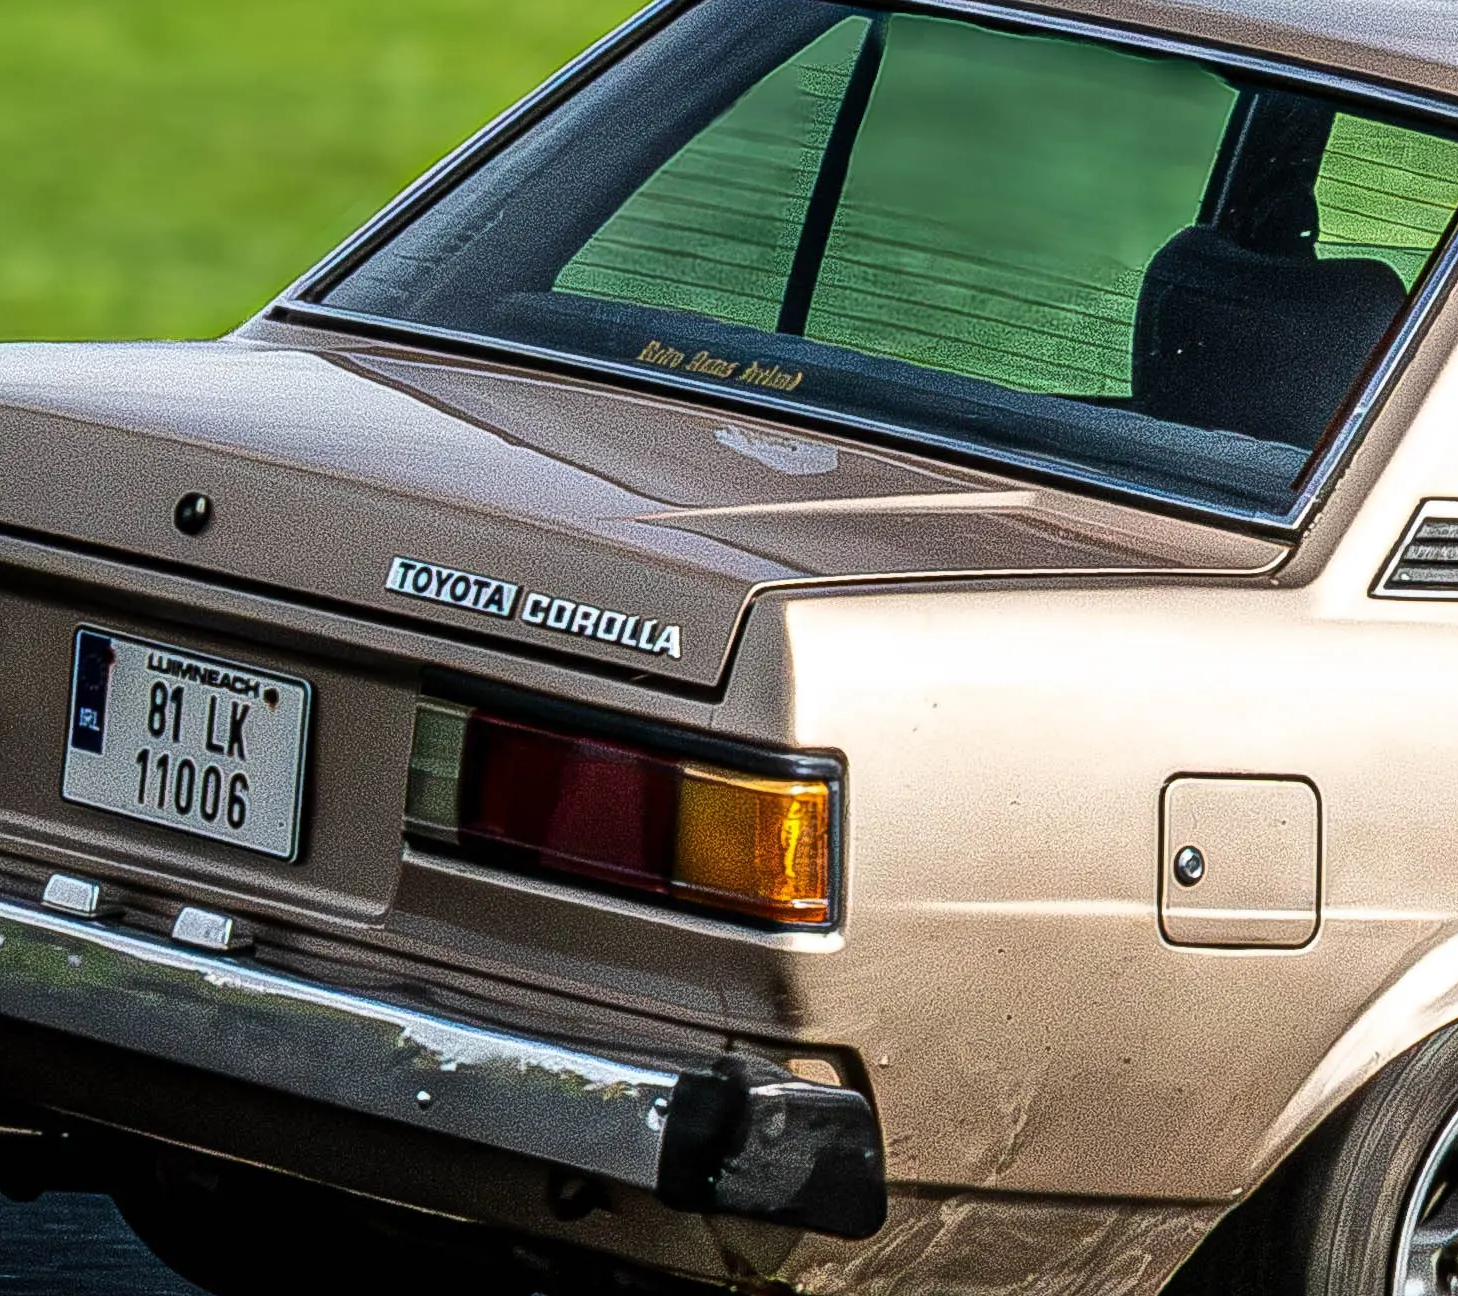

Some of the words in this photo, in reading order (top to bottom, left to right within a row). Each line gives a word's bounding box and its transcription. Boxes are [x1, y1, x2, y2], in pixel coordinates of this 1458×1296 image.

[397, 560, 508, 613] TOYOTA
[521, 592, 681, 658] COROLLA
[146, 652, 260, 699] LUIMNEACH
[147, 680, 185, 744] 81
[205, 694, 250, 762] LK
[136, 748, 249, 830] 11006
